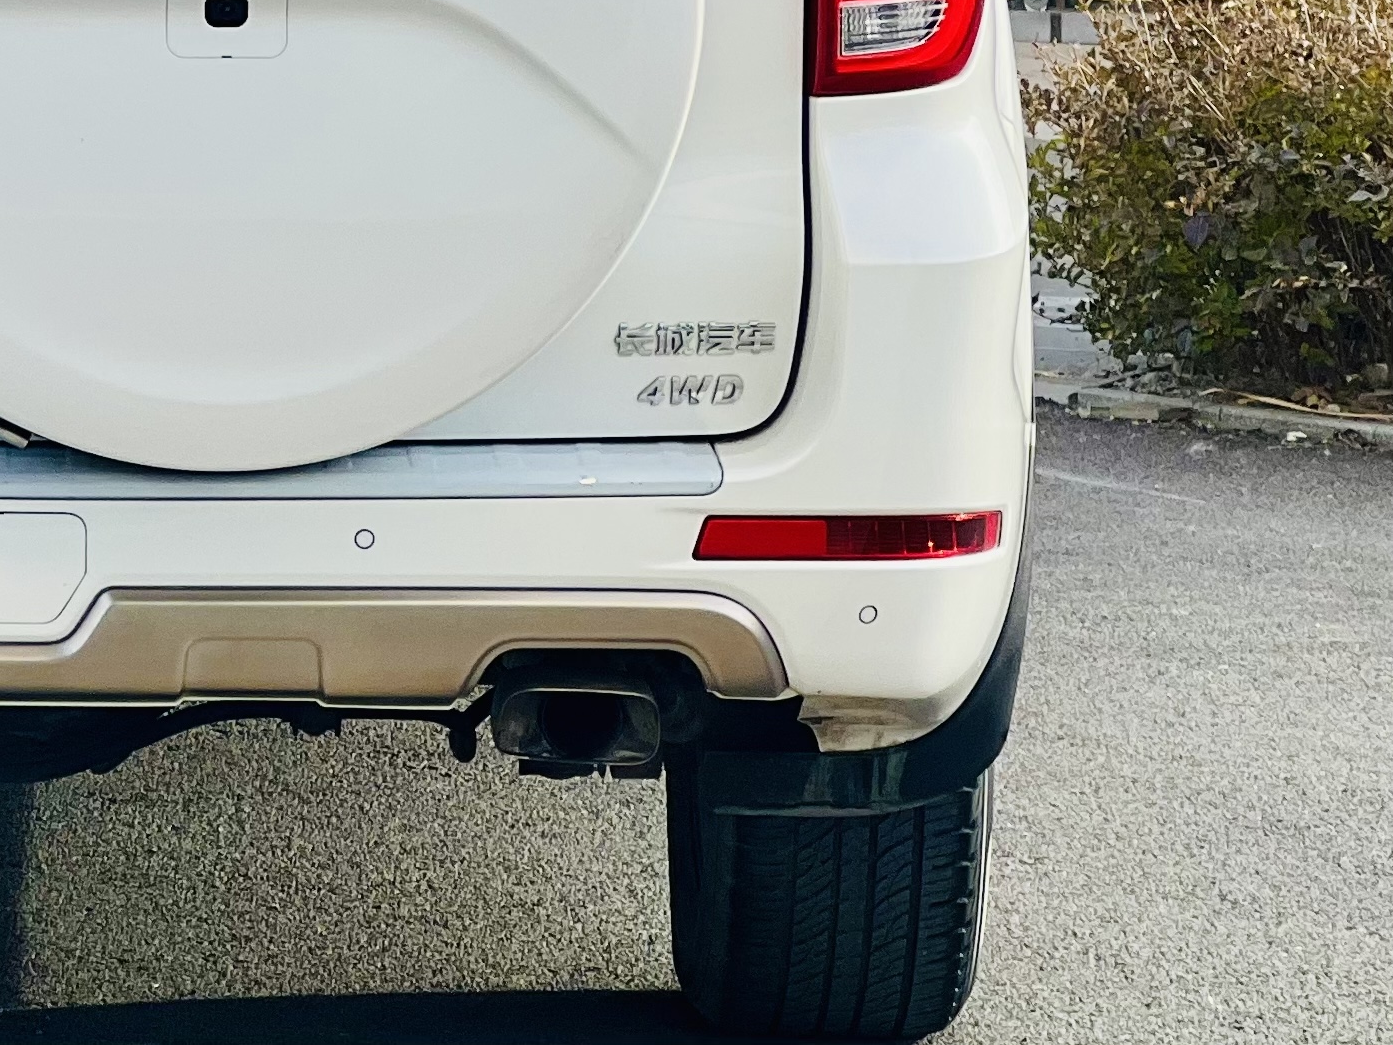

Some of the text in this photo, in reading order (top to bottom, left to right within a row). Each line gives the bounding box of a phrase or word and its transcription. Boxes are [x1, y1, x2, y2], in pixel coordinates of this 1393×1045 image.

[614, 320, 776, 356] 长城汽车
[636, 373, 745, 406] 4WD
